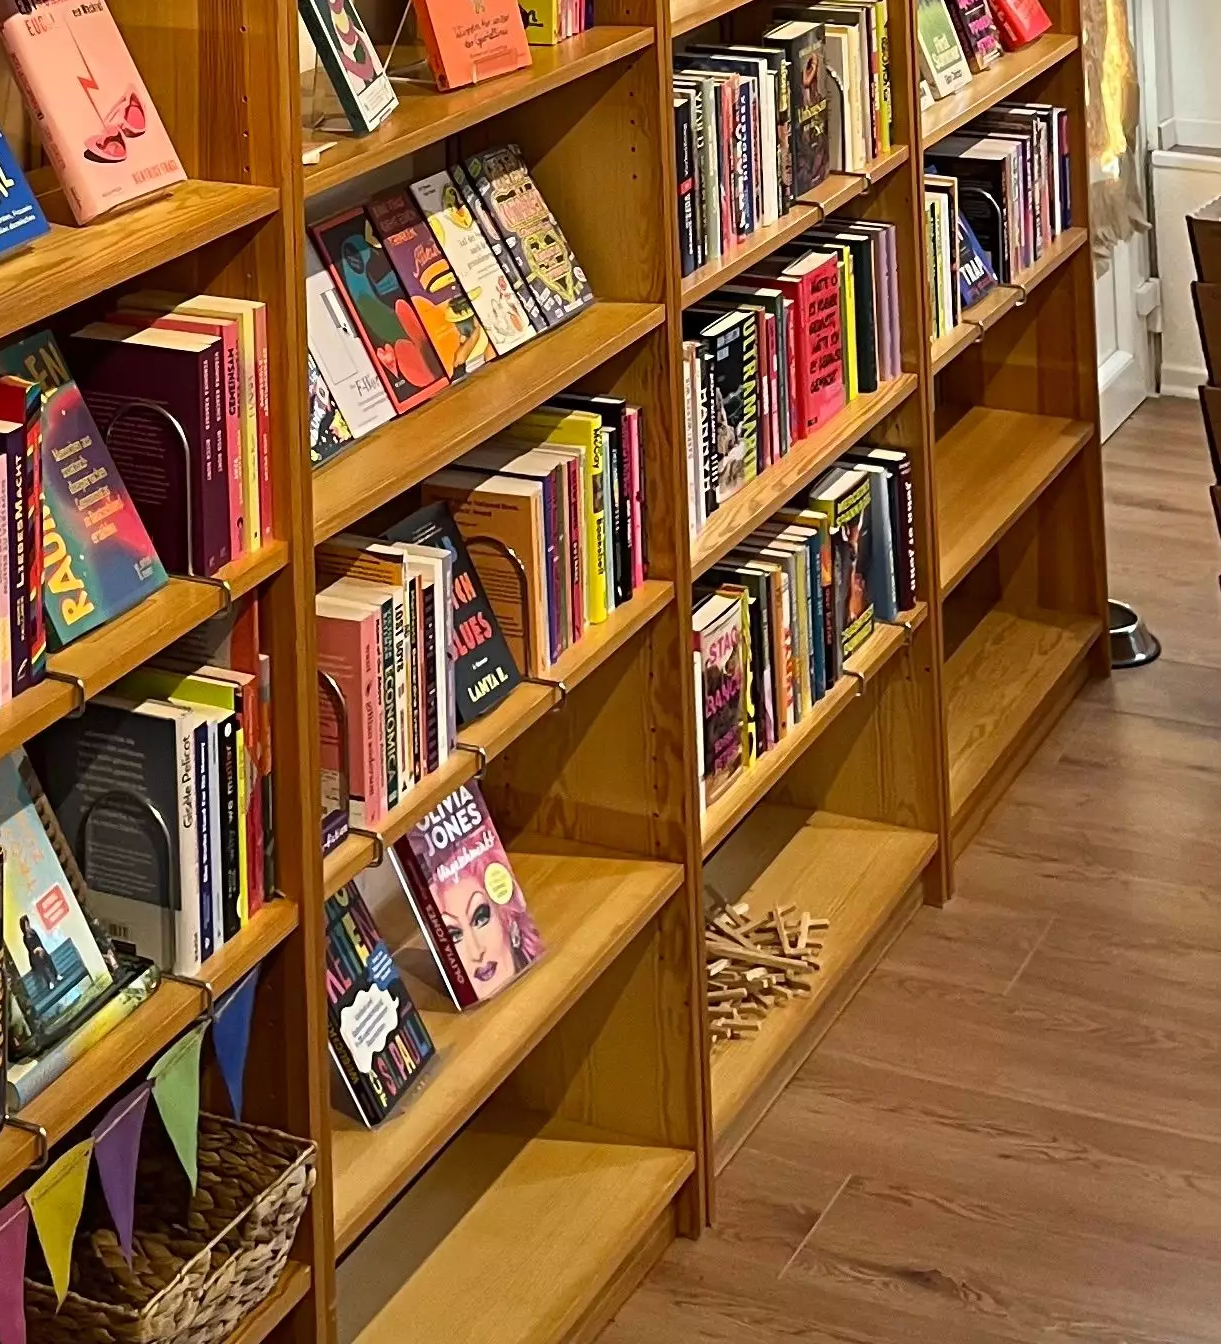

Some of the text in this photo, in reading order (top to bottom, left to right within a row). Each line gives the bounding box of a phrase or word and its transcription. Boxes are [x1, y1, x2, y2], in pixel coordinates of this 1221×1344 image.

[384, 663, 396, 784] ECONOMICA
[181, 734, 192, 783] Pelicot
[416, 786, 475, 833] OLIVIA
[421, 802, 483, 857] JONES
